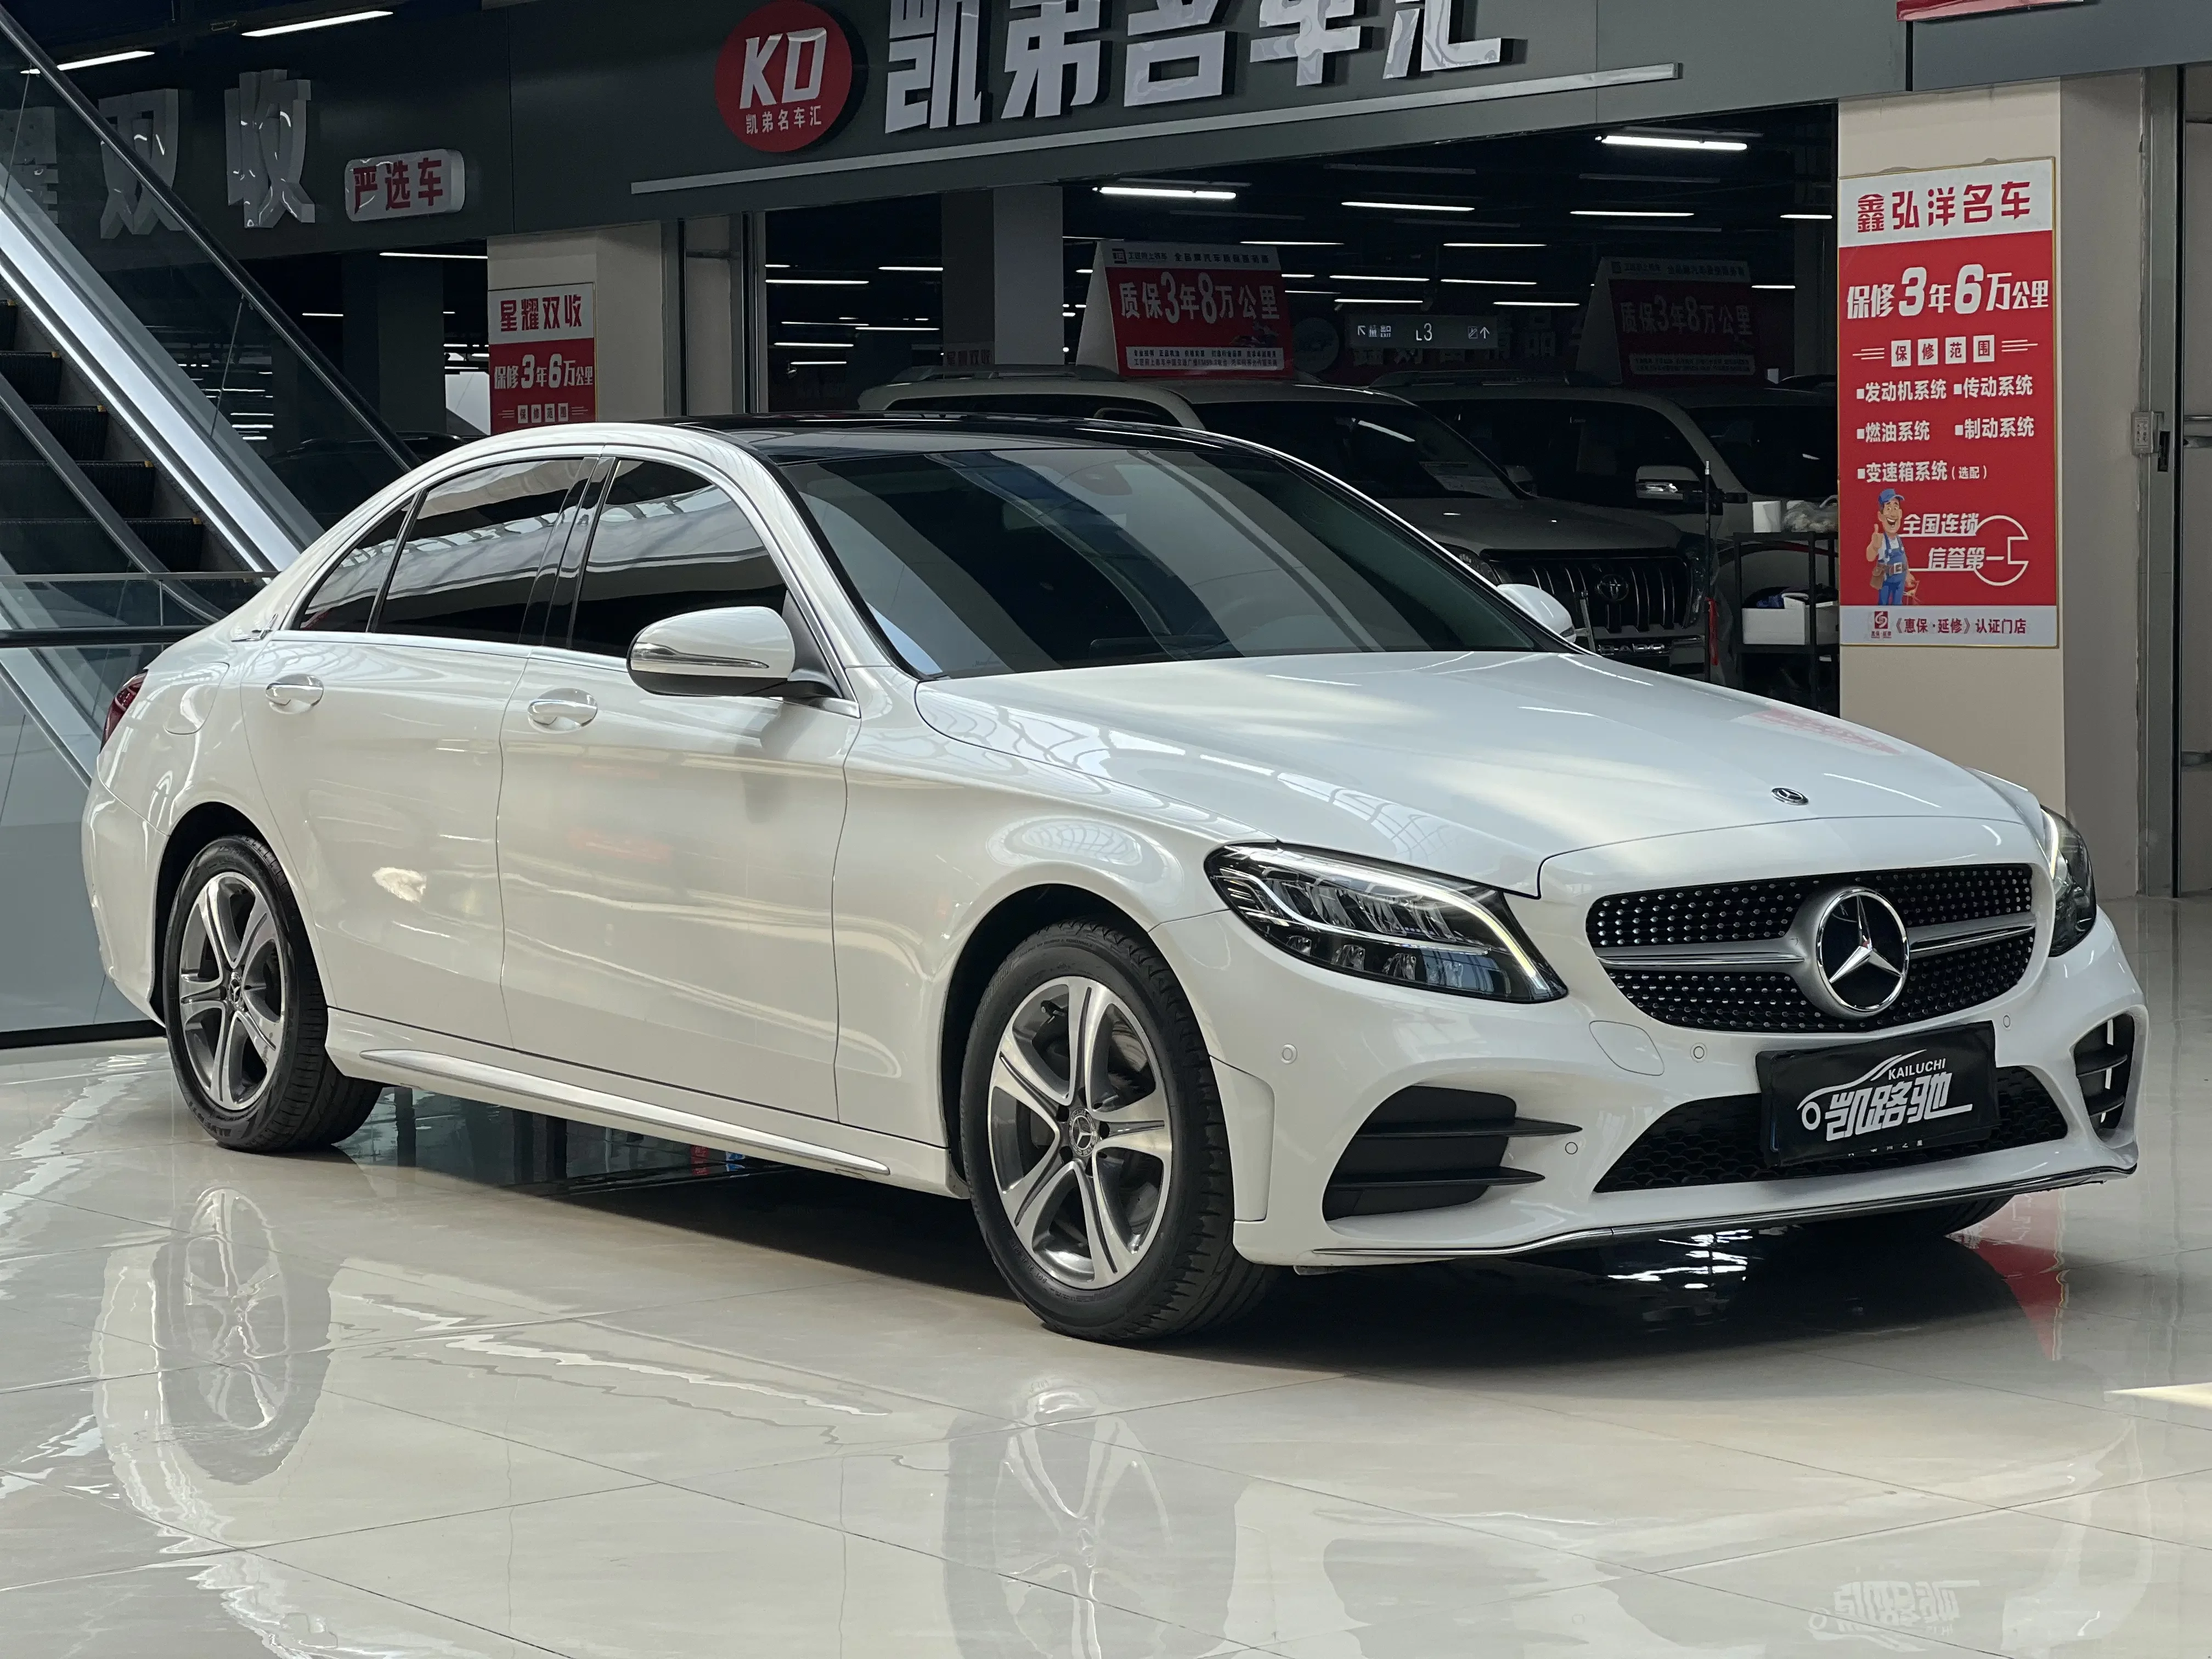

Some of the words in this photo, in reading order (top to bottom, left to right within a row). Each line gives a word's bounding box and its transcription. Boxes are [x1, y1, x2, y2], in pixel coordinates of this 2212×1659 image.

[745, 105, 822, 136] 凯弟名车汇
[353, 157, 444, 213] 严选车
[1857, 181, 2031, 233] 鑫弘洋名车
[1119, 271, 1280, 324] 质保3年8万公里
[1846, 263, 2050, 320] 保修3年6万公里
[500, 294, 583, 332] 星耀双收
[1415, 322, 1432, 341] L3
[1894, 338, 1992, 363] 保修范围
[494, 353, 594, 390] 保修3年6万公里
[1865, 380, 1947, 403] 发动机系统
[1963, 375, 2033, 398] 传动系统
[1865, 420, 1930, 443] 燃油系统
[1964, 416, 2034, 439] 制动系统
[1903, 513, 1979, 535] 全国连锁
[1928, 547, 2005, 569] 信誉第一
[1888, 1058, 1946, 1081] KAILUCHI
[1825, 1071, 1972, 1141] 凯路驰
